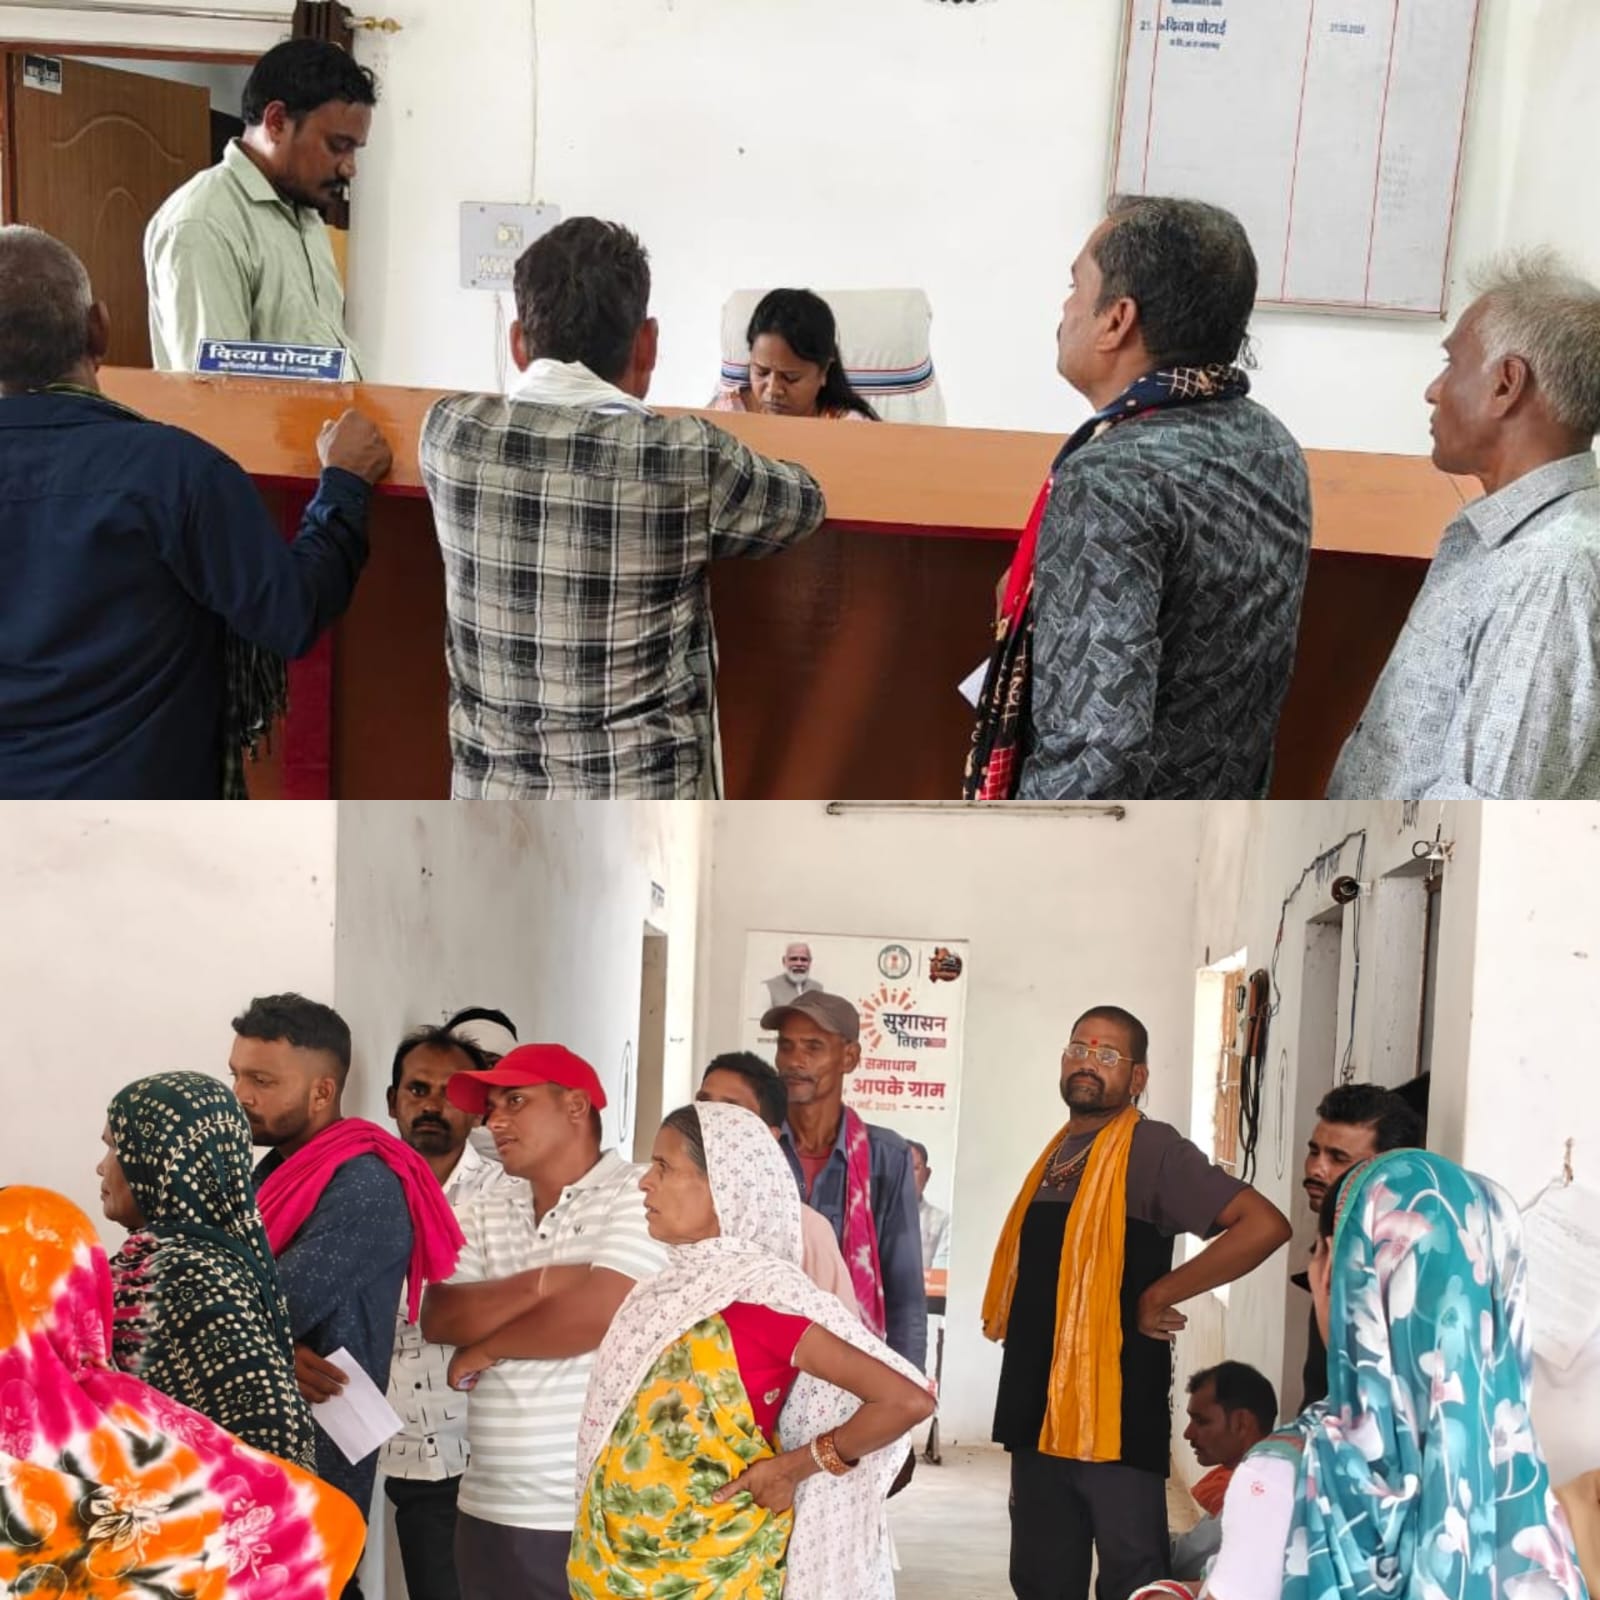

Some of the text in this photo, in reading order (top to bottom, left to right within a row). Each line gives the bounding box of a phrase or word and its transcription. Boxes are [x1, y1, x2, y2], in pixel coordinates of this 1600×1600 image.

[209, 344, 333, 367] दिव्या पोटाई
[882, 1013, 947, 1034] सुशासन
[864, 1057, 917, 1072] समाधान
[853, 1075, 946, 1098] आपके ग्राम
